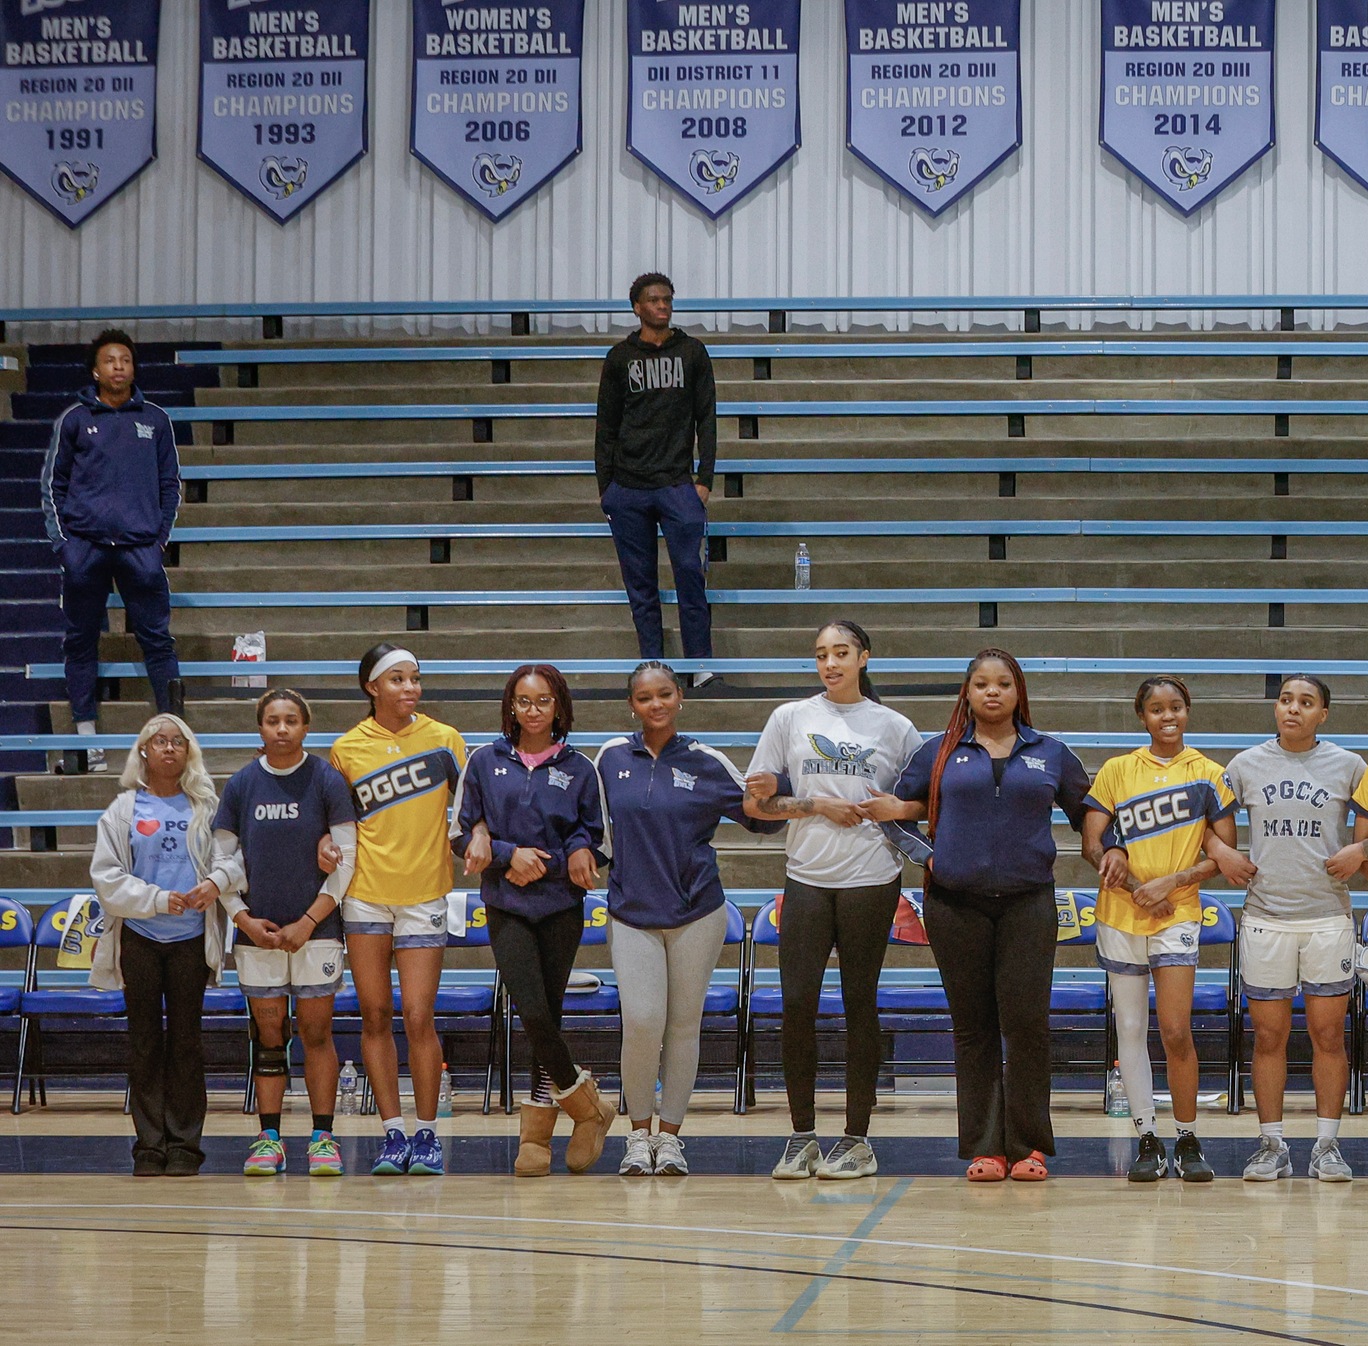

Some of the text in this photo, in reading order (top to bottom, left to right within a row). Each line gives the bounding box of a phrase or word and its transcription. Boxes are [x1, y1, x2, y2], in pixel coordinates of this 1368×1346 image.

[248, 11, 320, 34] MEN'S
[446, 8, 551, 30] WOMEN'S
[678, 5, 750, 27] MEN'S
[897, 3, 969, 24] MEN'S
[1151, 1, 1224, 23] MEN'S
[41, 15, 112, 40] MEN'S
[859, 26, 1007, 50] BASKETBALL
[1114, 25, 1262, 48] BASKETBALL
[212, 36, 356, 59] BASKETBALL
[425, 33, 572, 55] BASKETBALL
[641, 29, 788, 52] BASKETBALL
[6, 40, 148, 65] BASKETBALL
[227, 71, 342, 88] REGION 20 DII
[439, 69, 557, 85] REGION 20 DII
[648, 65, 780, 82] DII DISTRICT 11
[871, 63, 996, 80] REGION 20 DIII
[1125, 62, 1250, 78] REGION 20 DIII
[20, 77, 134, 93] REGION 20 DII
[1115, 85, 1260, 107] CHAMPIONS
[213, 93, 353, 117] CHAMPIONS
[426, 91, 569, 114] CHAMPIONS
[642, 87, 786, 111] CHAMPIONS
[861, 86, 1006, 109] CHAMPIONS
[7, 100, 145, 122] CHAMPIONS
[253, 123, 316, 145] 1993
[464, 121, 530, 142] 2006
[681, 117, 747, 138] 2008
[901, 115, 968, 137] 2012
[1154, 114, 1221, 136] 2014
[45, 129, 104, 150] 1991
[646, 357, 685, 389] NBA
[357, 760, 432, 810] PGCC
[1262, 779, 1330, 809] PGCC
[254, 802, 299, 821] OWLS
[1118, 792, 1191, 836] PGCC
[165, 820, 188, 832] PG
[1263, 819, 1322, 838] MADE
